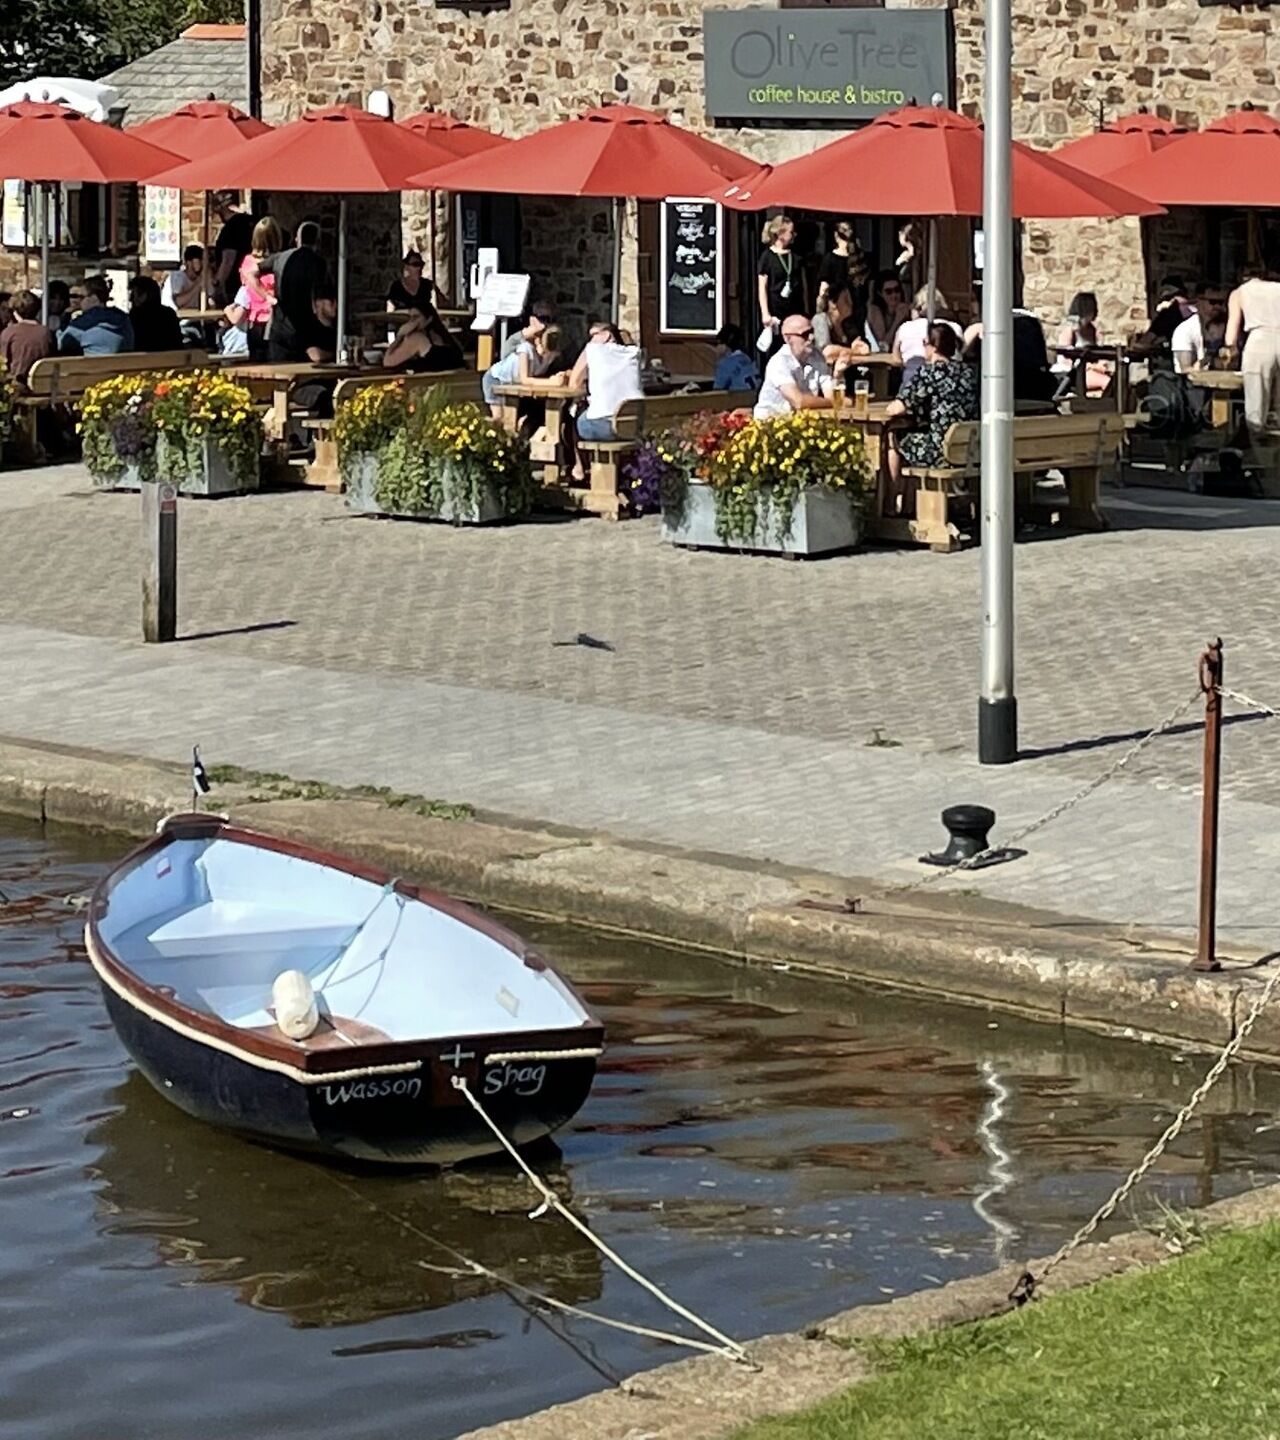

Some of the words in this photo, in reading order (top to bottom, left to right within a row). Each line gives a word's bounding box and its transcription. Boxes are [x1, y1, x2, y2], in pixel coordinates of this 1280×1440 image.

[731, 25, 839, 79] Olive
[838, 27, 919, 80] Tree
[748, 84, 793, 103] coffee
[797, 85, 840, 103] house
[844, 84, 857, 104] &
[861, 85, 904, 104] bistro
[317, 1077, 422, 1106] Wasson
[483, 1063, 547, 1095] Shag
